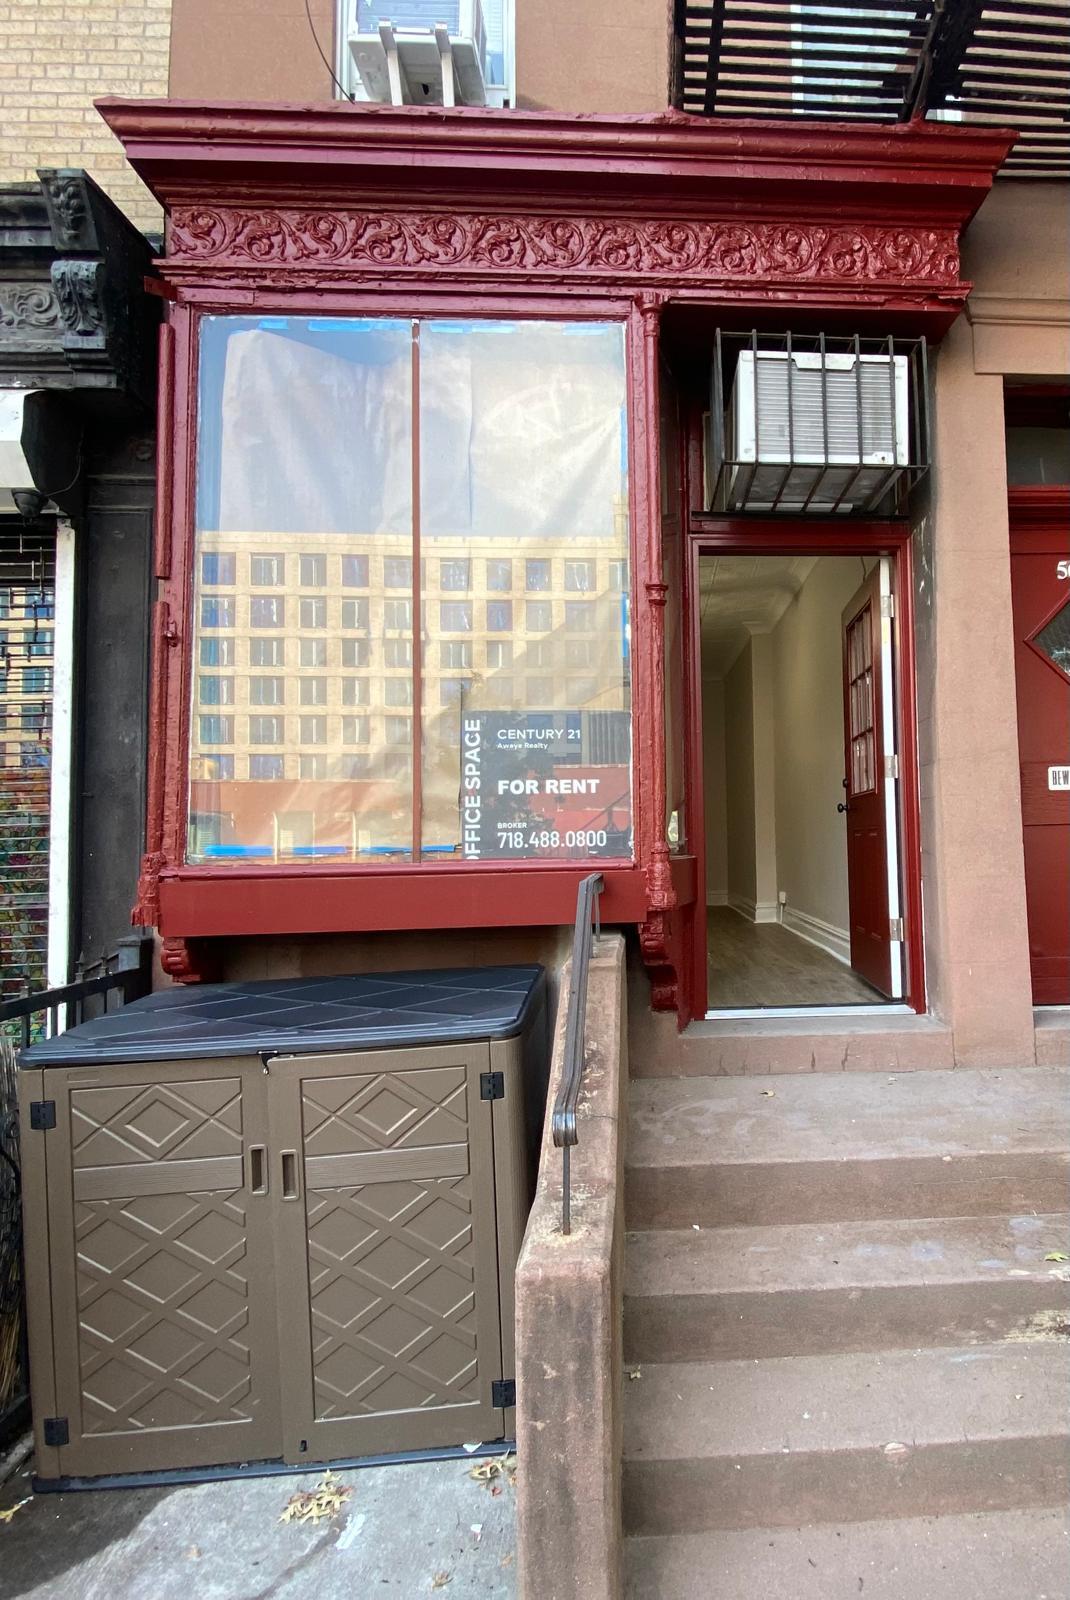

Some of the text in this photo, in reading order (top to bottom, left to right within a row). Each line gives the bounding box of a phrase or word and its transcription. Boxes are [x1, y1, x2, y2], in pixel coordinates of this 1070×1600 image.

[497, 729, 581, 740] CENTURY 21
[524, 742, 549, 750] Realty
[464, 719, 481, 790] SPACE
[498, 779, 600, 795] FOR RENT
[497, 830, 607, 849] 718.488.0800
